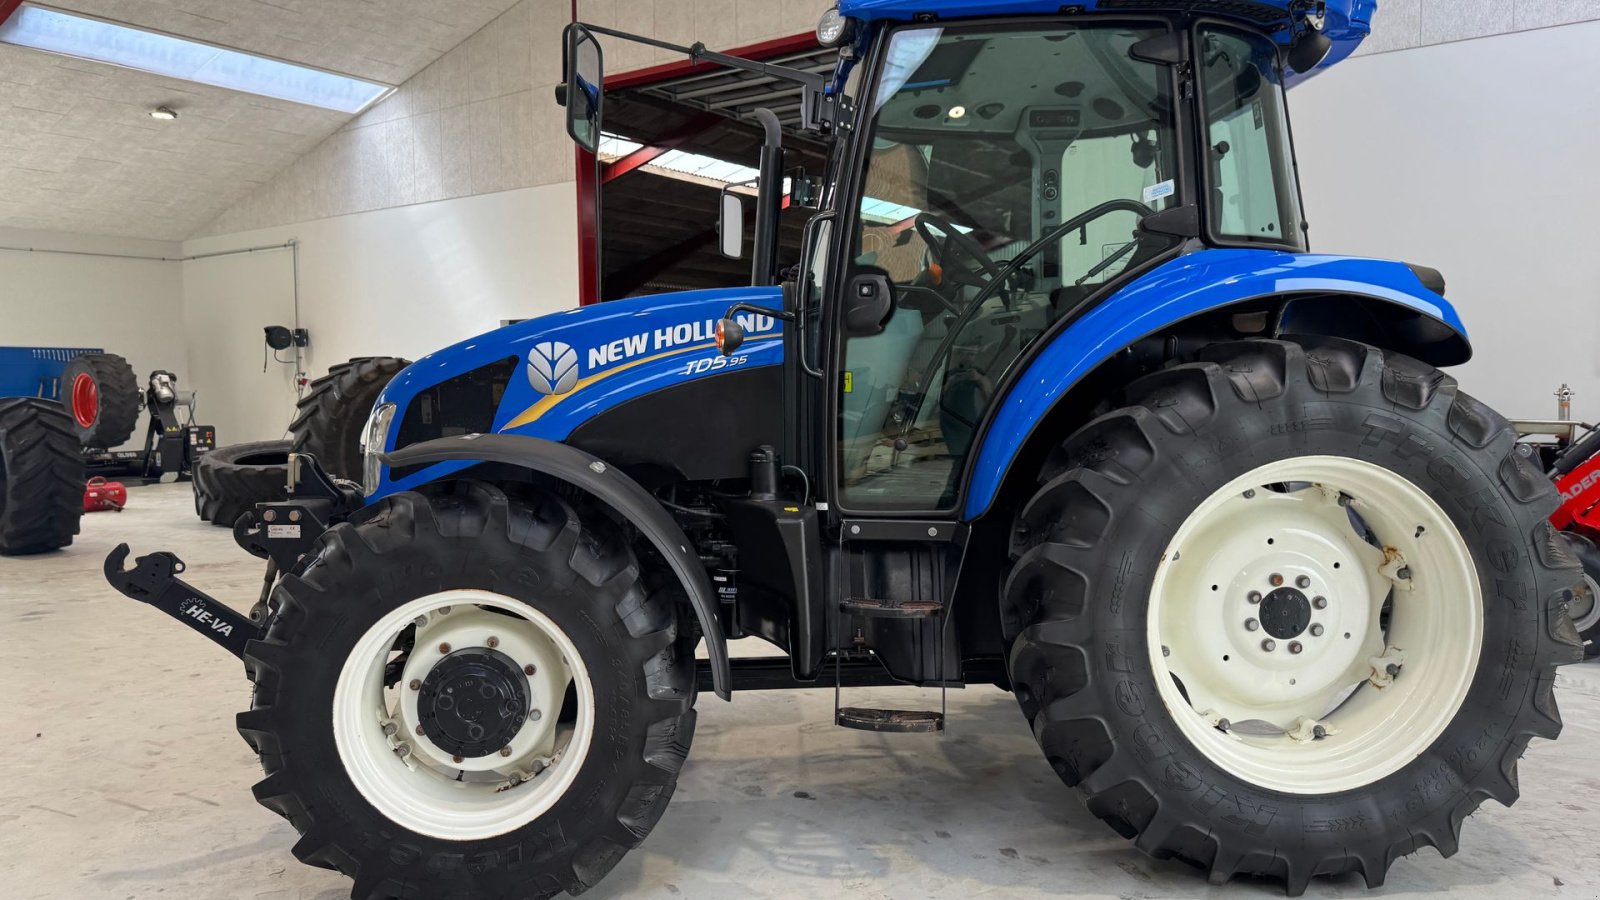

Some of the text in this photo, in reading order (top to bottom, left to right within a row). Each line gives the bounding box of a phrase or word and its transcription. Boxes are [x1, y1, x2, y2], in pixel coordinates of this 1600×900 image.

[588, 314, 775, 370] NEW HOLLND
[186, 605, 234, 637] HE-VA
